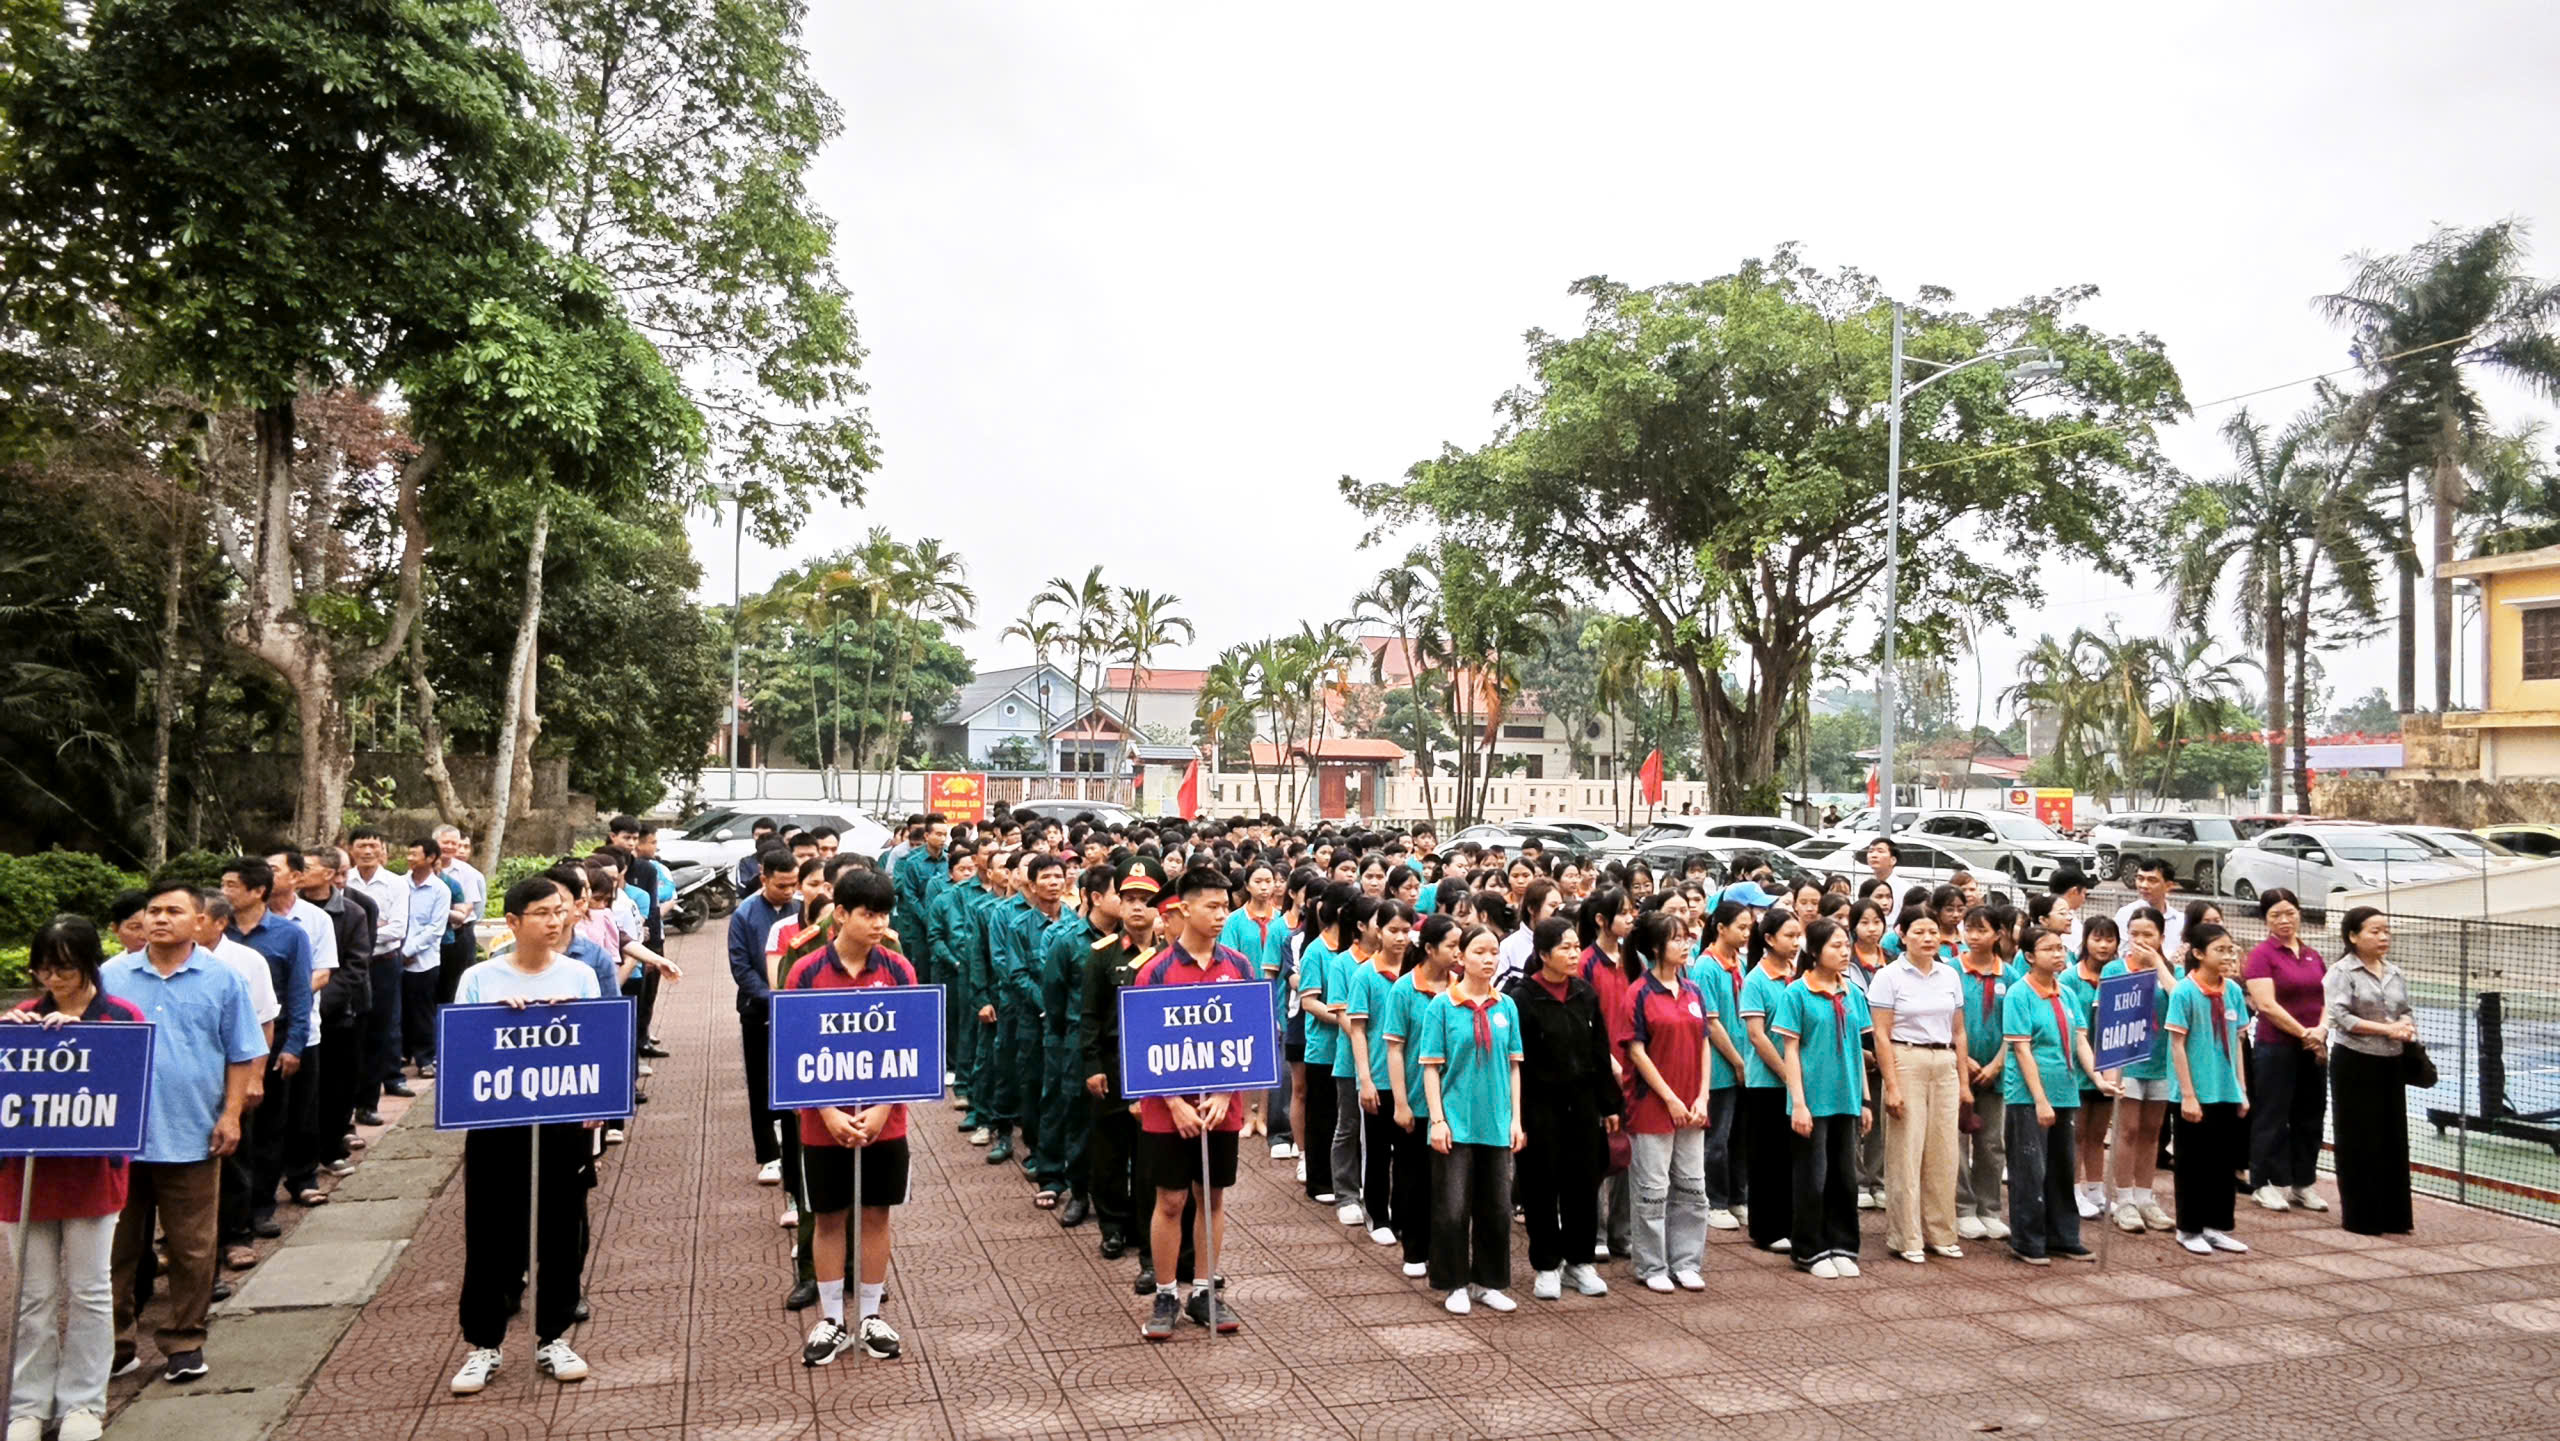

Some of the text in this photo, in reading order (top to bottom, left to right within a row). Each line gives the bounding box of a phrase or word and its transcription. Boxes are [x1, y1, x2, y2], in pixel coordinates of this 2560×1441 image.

[1163, 995, 1233, 1027] KHỐI
[2114, 983, 2142, 1012] KHỐI
[493, 1014, 581, 1050] KHỐI
[819, 1001, 897, 1035] KHỐI
[2102, 1018, 2147, 1051] GIÁO DỤC
[0, 1037, 92, 1073] KHỐI
[797, 1046, 918, 1084] CÔNG AN
[1147, 1035, 1255, 1076] QUÂN SỰ
[473, 1063, 600, 1102] CƠ QUAN
[0, 1086, 118, 1128] C THÔN
